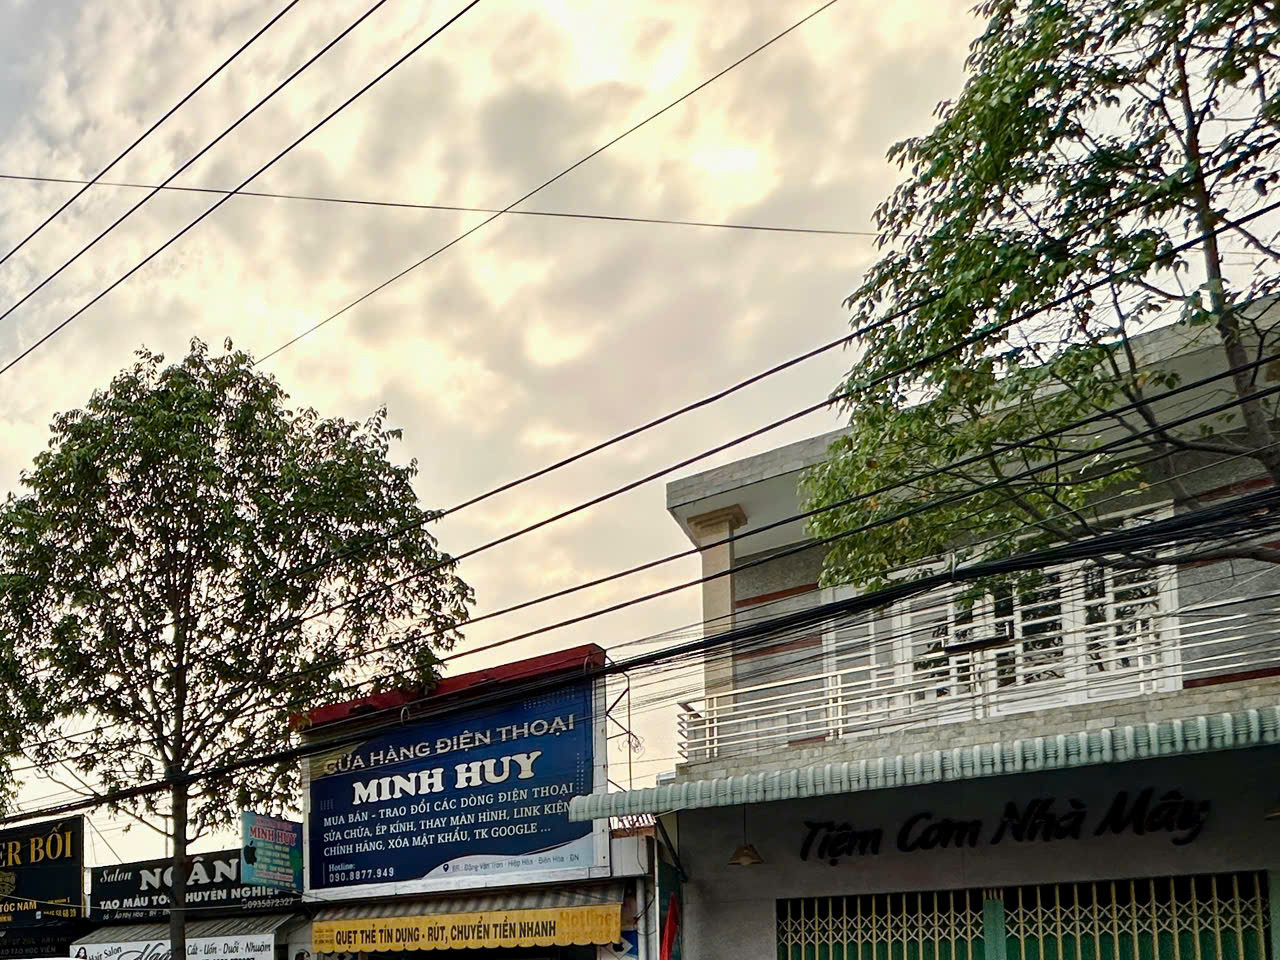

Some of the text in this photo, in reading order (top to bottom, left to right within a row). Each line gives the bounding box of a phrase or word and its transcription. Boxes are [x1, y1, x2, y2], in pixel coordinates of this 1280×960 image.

[323, 714, 575, 775] CỬA HÀNG ĐIỆN THOẠI
[352, 751, 542, 805] MINH HUY
[323, 816, 345, 828] MUA
[348, 811, 368, 824] BÁN
[379, 807, 407, 819] TRAO
[410, 799, 430, 815] ĐỔI
[434, 797, 457, 811] CÁC
[460, 793, 494, 808] DÒNG
[498, 788, 528, 803] ĐIỆN
[532, 783, 574, 798] THOẠI
[249, 825, 276, 842] MINH
[276, 829, 297, 847] HUY
[323, 828, 342, 843] SỬA
[375, 823, 387, 836] ÉP
[419, 817, 447, 830] THAY
[450, 812, 475, 826] MÀN
[478, 808, 510, 823] HÌNH,
[513, 805, 541, 819] LINK
[323, 843, 353, 857] CHÍNH
[388, 836, 410, 849] XÓA
[412, 833, 435, 848] MẬT
[473, 828, 489, 840] TK
[491, 823, 538, 837] GOOGLE
[799, 819, 883, 866] Tiệm
[991, 796, 1089, 845] Nhà
[1095, 786, 1211, 846] Mây
[30, 822, 73, 864] BỐI
[99, 868, 132, 884] Salon
[0, 901, 16, 914] TÓC
[17, 900, 37, 912] NAM
[99, 899, 120, 912] TẠO
[151, 892, 171, 906] TÓ
[185, 887, 227, 903] HUYÊN
[335, 930, 358, 949] QUẸT
[360, 923, 376, 945] THẺ
[378, 924, 393, 944] TÍN
[395, 928, 420, 947] DỤNG
[519, 920, 557, 938] NHANH
